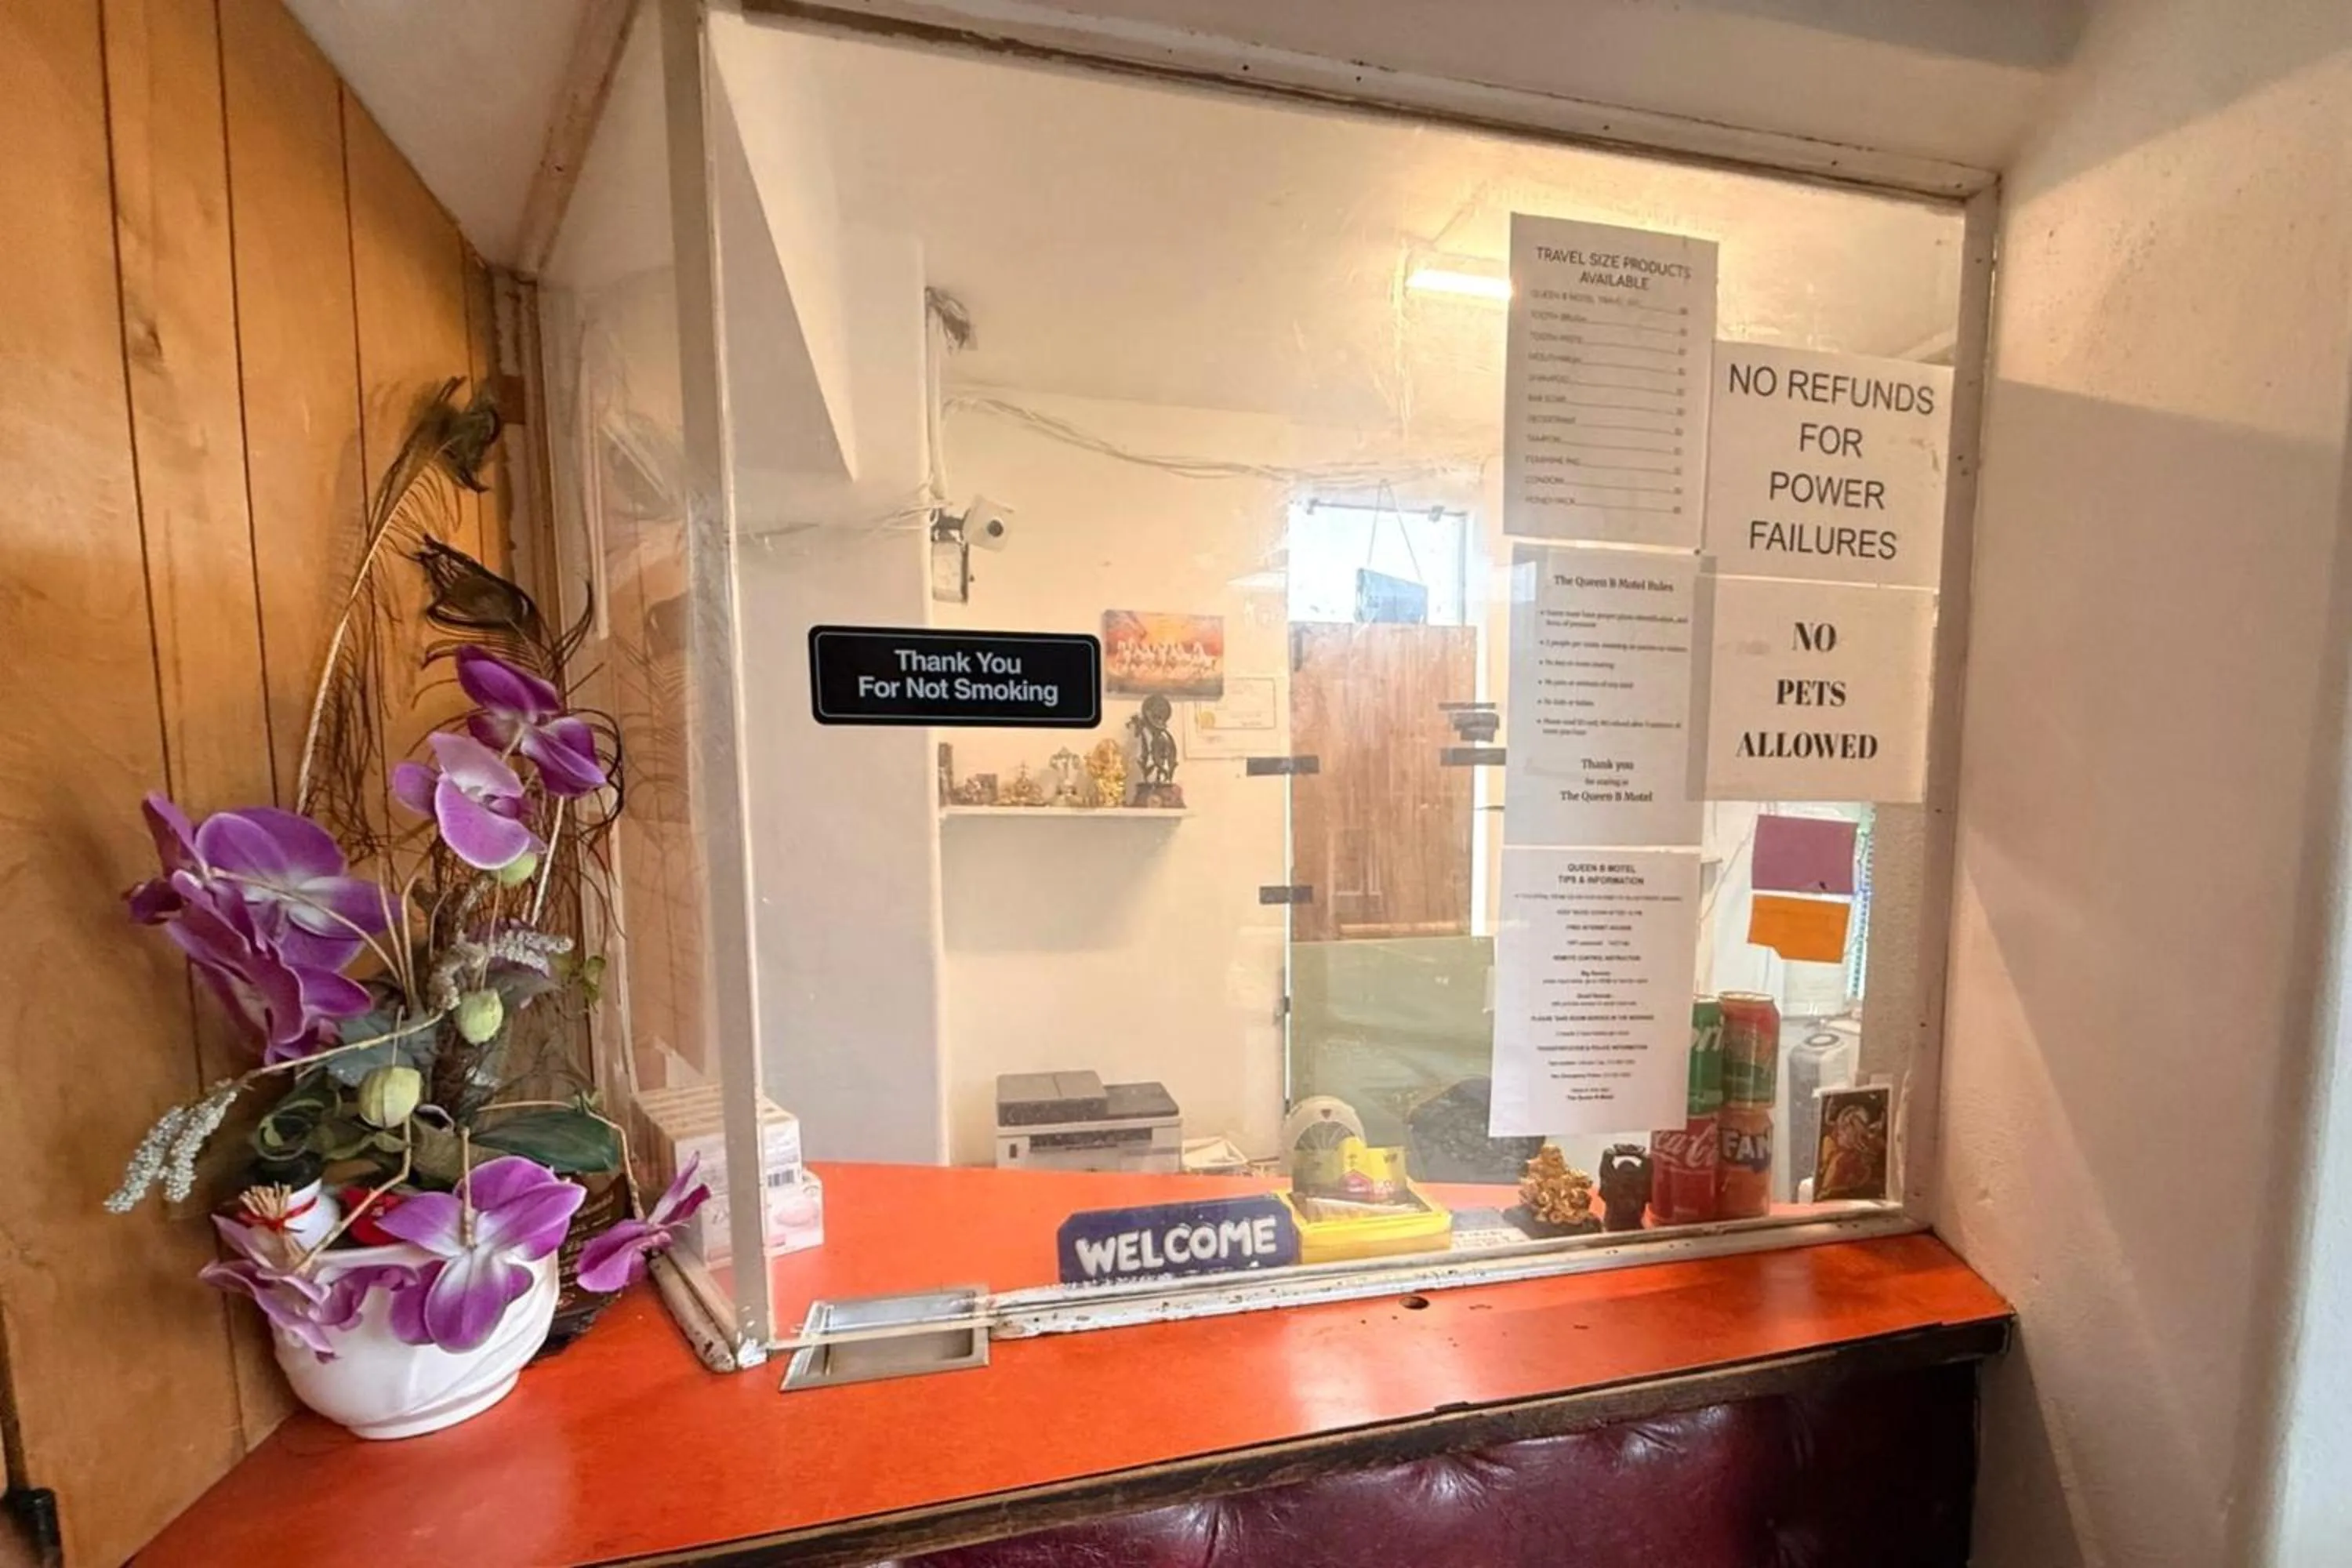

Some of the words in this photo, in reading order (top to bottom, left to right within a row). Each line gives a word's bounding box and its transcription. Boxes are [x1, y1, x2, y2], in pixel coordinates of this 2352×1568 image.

[1537, 246, 1585, 265] TRAVEL
[1589, 252, 1621, 269] SIZE
[1623, 256, 1691, 279] PRODUCTS
[1579, 270, 1650, 291] AVAILABLE
[1730, 364, 1777, 397] NO
[1788, 368, 1934, 416] REFUNDS
[1799, 423, 1863, 458] FOR
[1769, 470, 1886, 510] POWER
[1749, 520, 1897, 560] FAILURES
[1554, 575, 1573, 586] The
[1576, 575, 1606, 588] Queen
[1609, 577, 1617, 587] B
[1619, 578, 1646, 590] Motel
[1647, 579, 1674, 592] Rules
[1791, 622, 1837, 652] NO
[895, 648, 971, 673] Thank
[976, 652, 1022, 673] You
[858, 676, 900, 698] For
[906, 677, 949, 699] Not
[954, 677, 1058, 706] Smoking
[1777, 679, 1847, 707] PETS
[1736, 731, 1878, 760] ALLOWED
[1581, 757, 1613, 769] Thank
[1616, 761, 1635, 772] you
[1559, 790, 1579, 801] The
[1581, 791, 1613, 804] Queen
[1615, 792, 1622, 801] B
[1624, 791, 1653, 801] Motel
[1559, 875, 1577, 884] TIPS
[1587, 876, 1644, 885] INFORMATION
[1568, 863, 1597, 873] QUEEN
[1599, 864, 1606, 873] B
[1607, 864, 1636, 873] MOTEL
[1075, 1215, 1278, 1276] WELCOME
